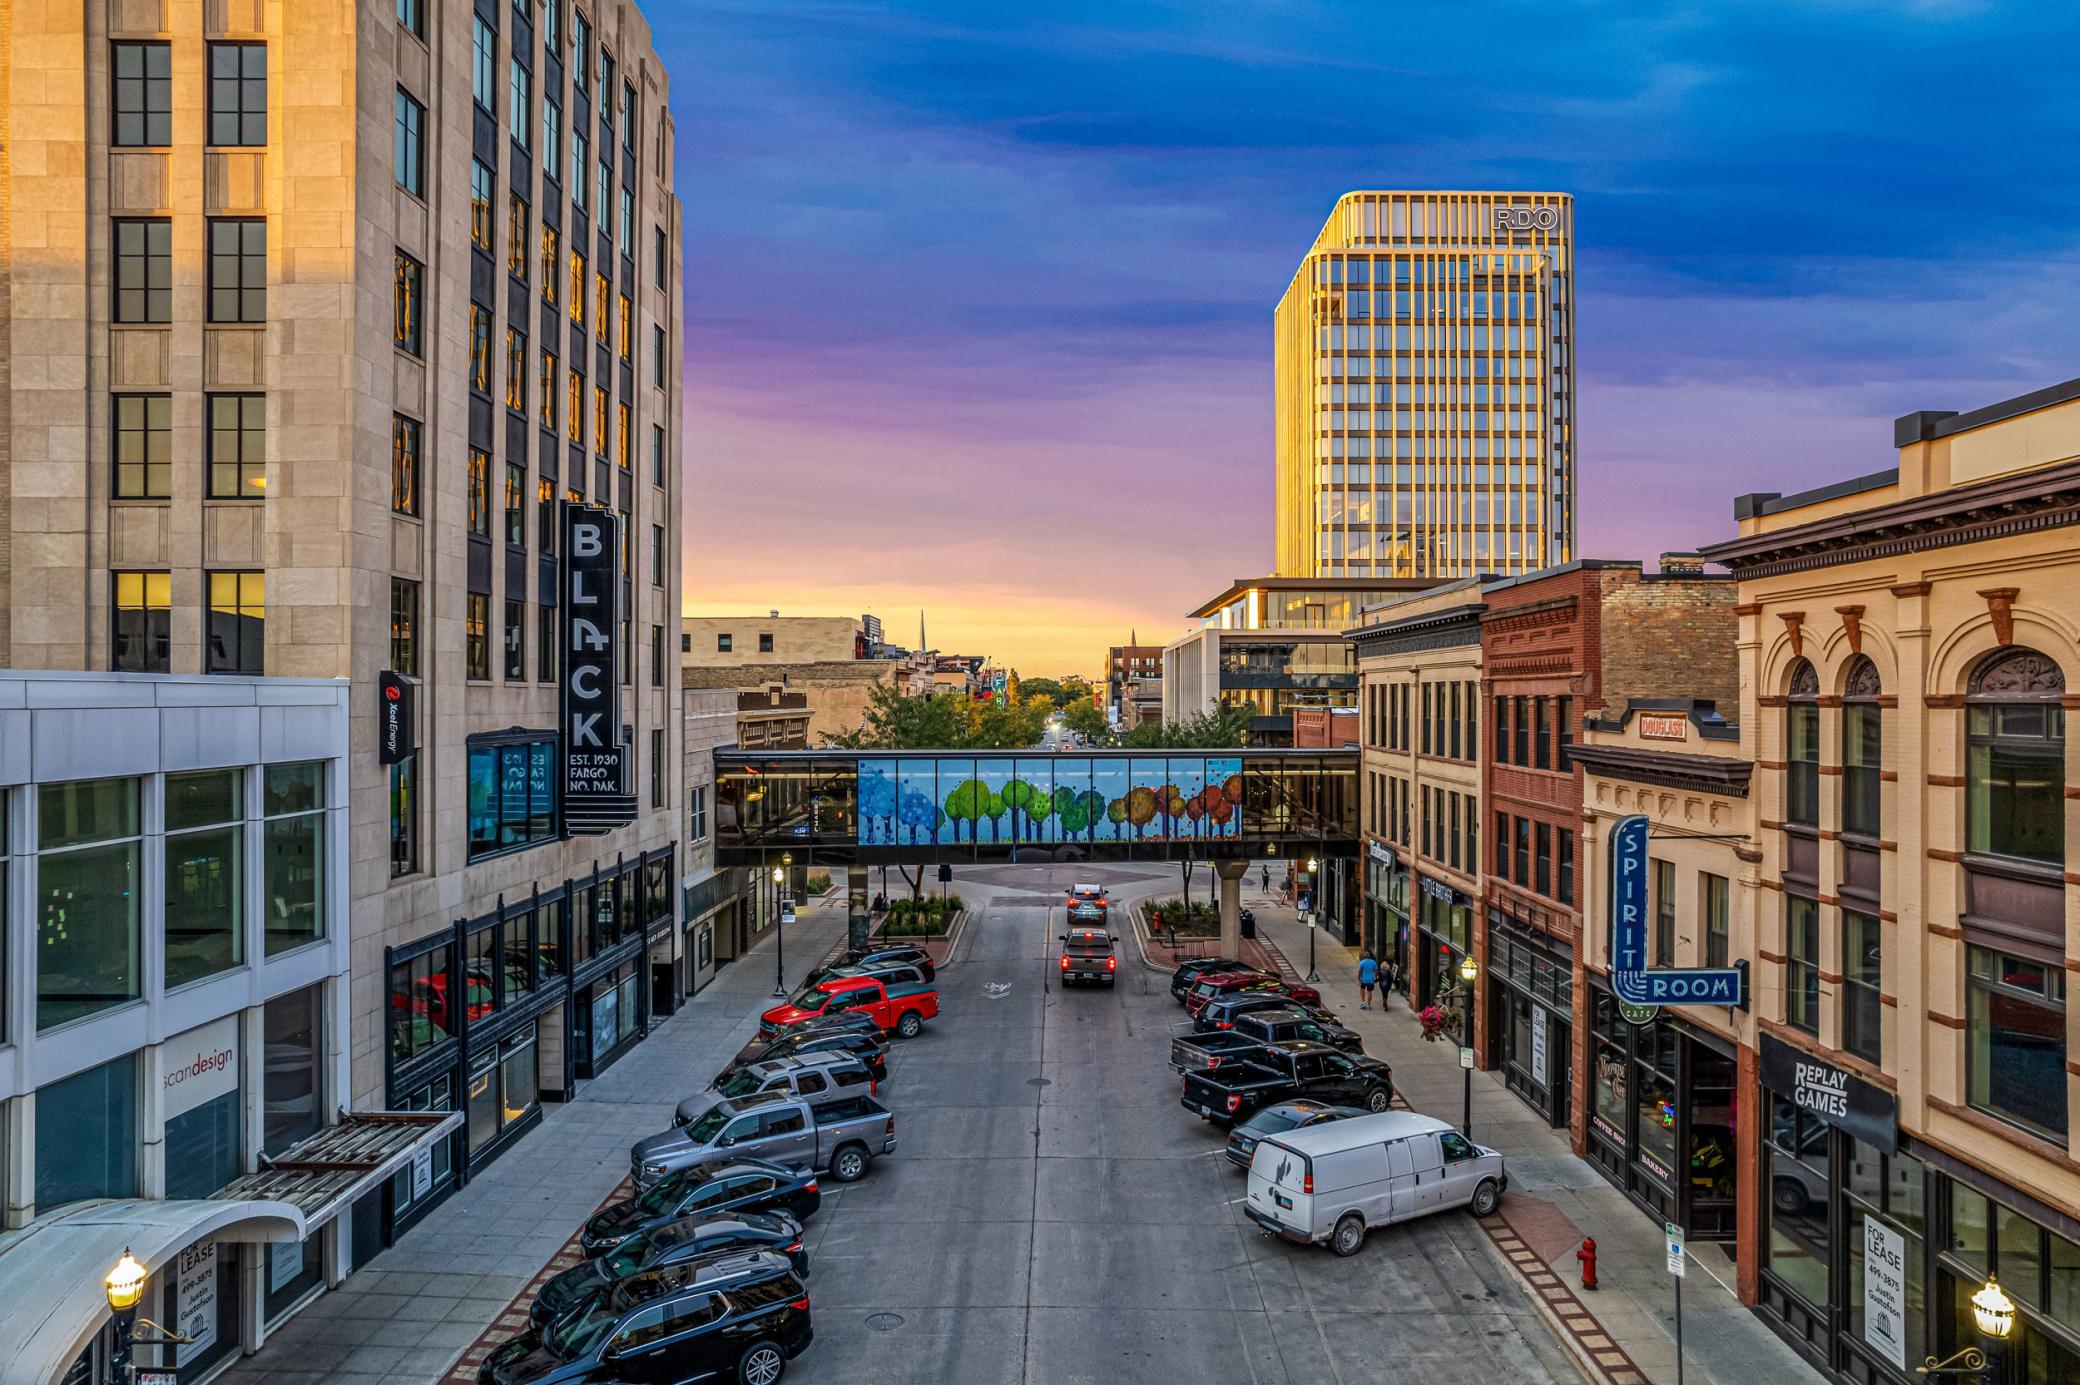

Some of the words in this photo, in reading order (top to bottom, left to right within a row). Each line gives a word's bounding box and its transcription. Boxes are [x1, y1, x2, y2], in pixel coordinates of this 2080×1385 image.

[1492, 207, 1558, 230] RDO
[571, 523, 609, 747] BLACK
[389, 702, 398, 723] Xcel
[388, 724, 398, 753] Energy
[570, 754, 591, 766] EST.
[593, 754, 619, 766] 1930
[570, 767, 608, 779] FARGO
[570, 780, 591, 792] NO.
[592, 780, 619, 792] DAK.
[1623, 834, 1639, 969] SPIRIT
[1653, 978, 1730, 998] ROOM
[1795, 1062, 1848, 1090] REPLAY
[1794, 1086, 1848, 1118] GAMES
[1641, 1153, 1670, 1181] BAKERY
[1867, 1224, 1885, 1246] FOR
[181, 1239, 199, 1258] FOR
[181, 1240, 214, 1276] LEASE
[1868, 1236, 1901, 1273] LEASE
[181, 1267, 213, 1295] 499-3875
[1868, 1264, 1900, 1293] 499-3875
[188, 1286, 209, 1306] Justin
[1874, 1282, 1896, 1304] Justin
